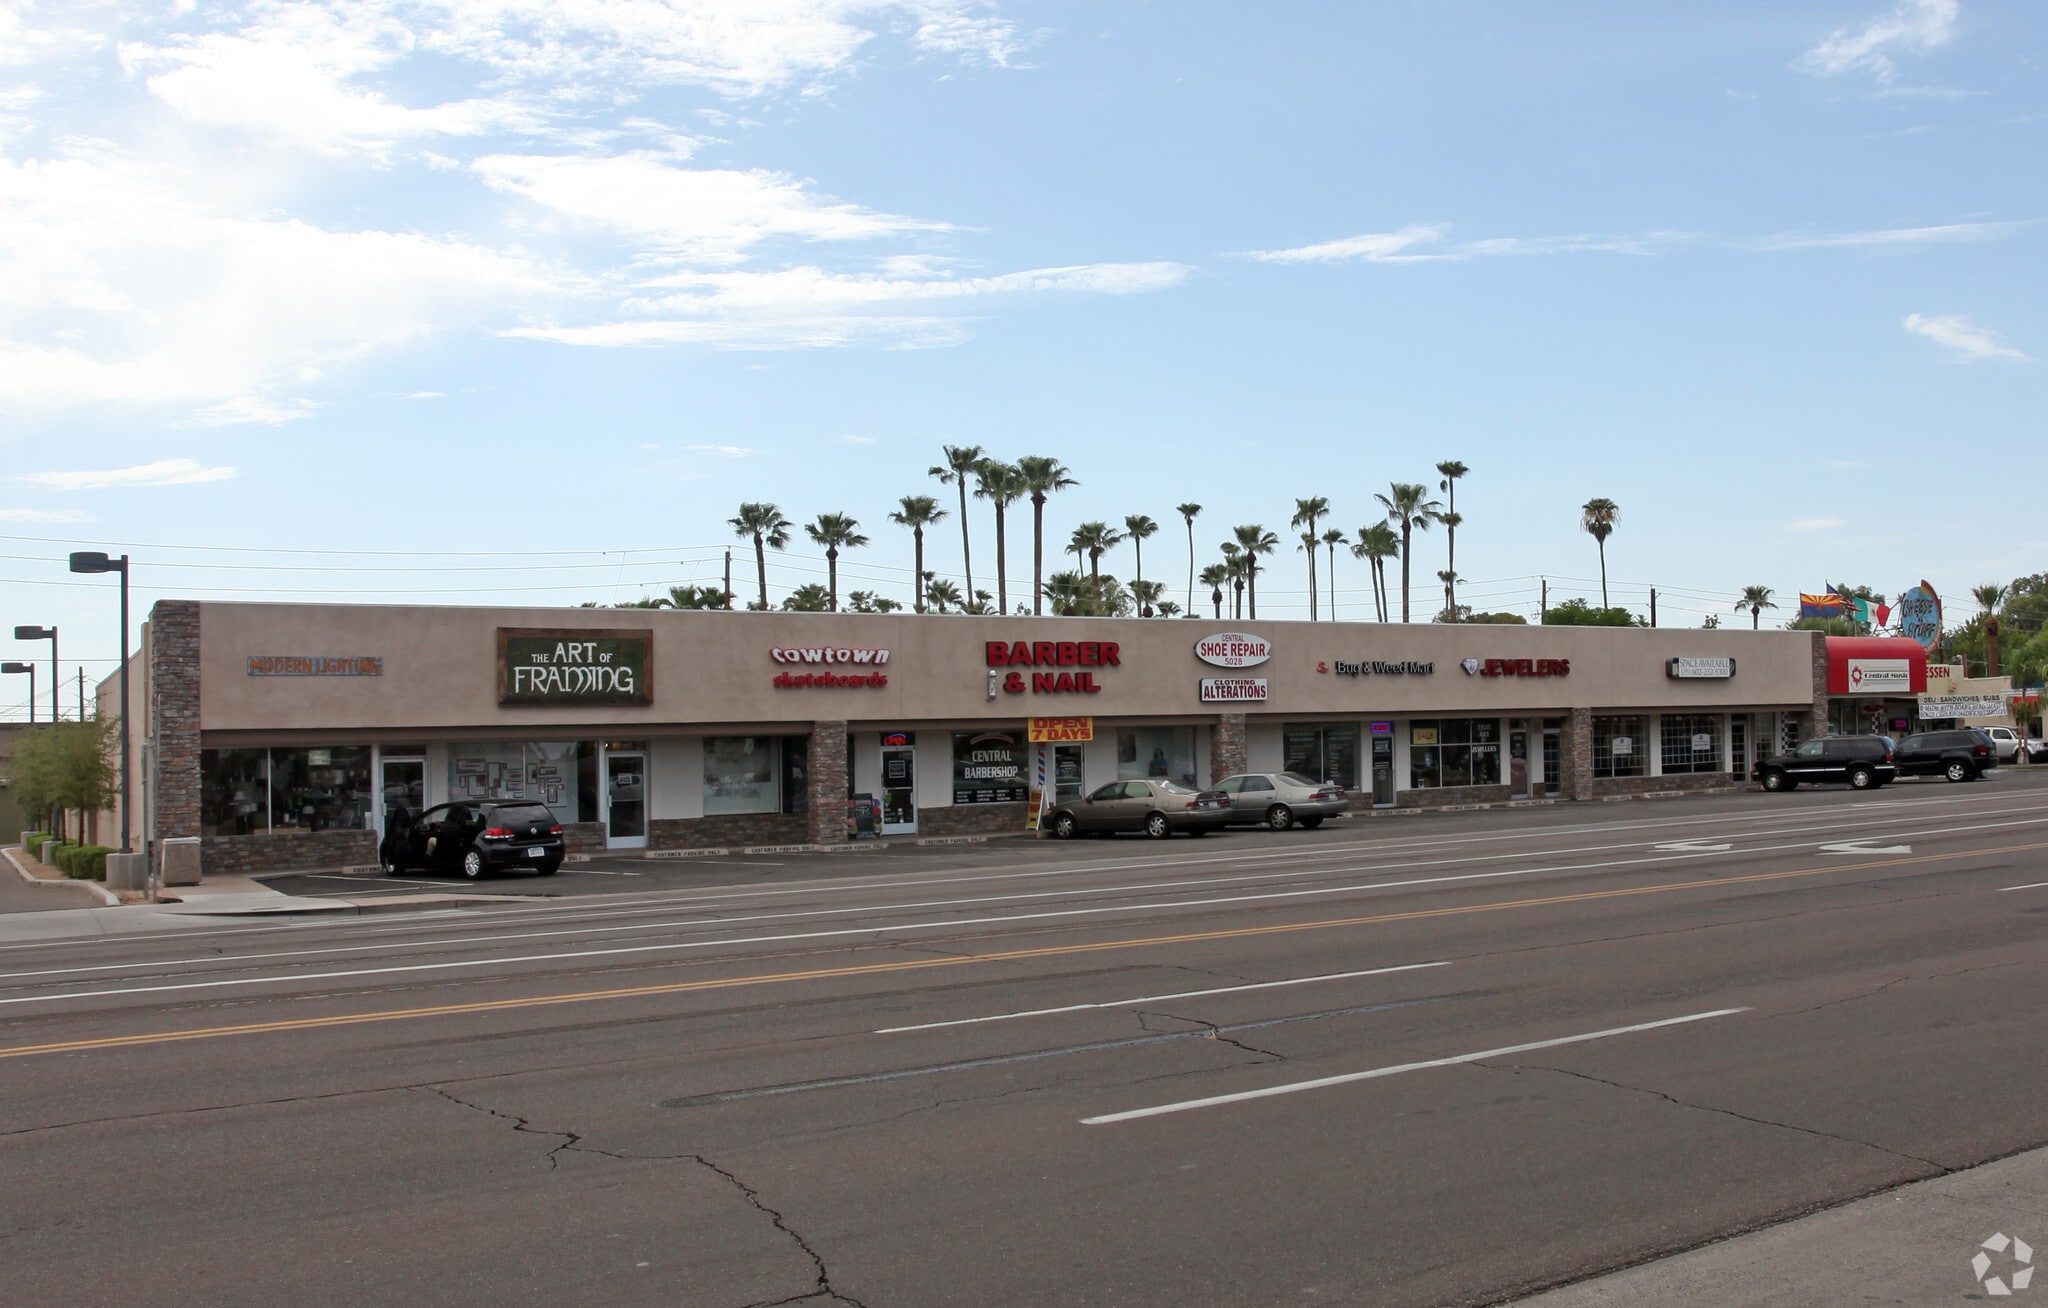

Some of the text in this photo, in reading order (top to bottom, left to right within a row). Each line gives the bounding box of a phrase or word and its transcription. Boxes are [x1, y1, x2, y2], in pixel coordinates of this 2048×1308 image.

[1222, 634, 1245, 642] CENTRAL
[531, 642, 613, 663] THE ART OF
[985, 641, 1121, 666] BARBER
[1201, 642, 1266, 657] SHOE REPAIR
[251, 658, 382, 674] MODERN LIGHTING
[1336, 661, 1360, 677] Bug
[1362, 661, 1372, 674] &
[1373, 661, 1406, 674] Weed
[1480, 659, 1571, 677] JEWELERS
[513, 666, 634, 695] FRAMING
[1004, 672, 1102, 692] & NAIL
[1203, 685, 1267, 698] ALTERATIONS
[1033, 718, 1088, 728] OPEN
[1031, 728, 1092, 740] 7 DAYS
[972, 750, 1012, 762] CENTRAL
[964, 766, 1018, 779] BARBERSHOP
